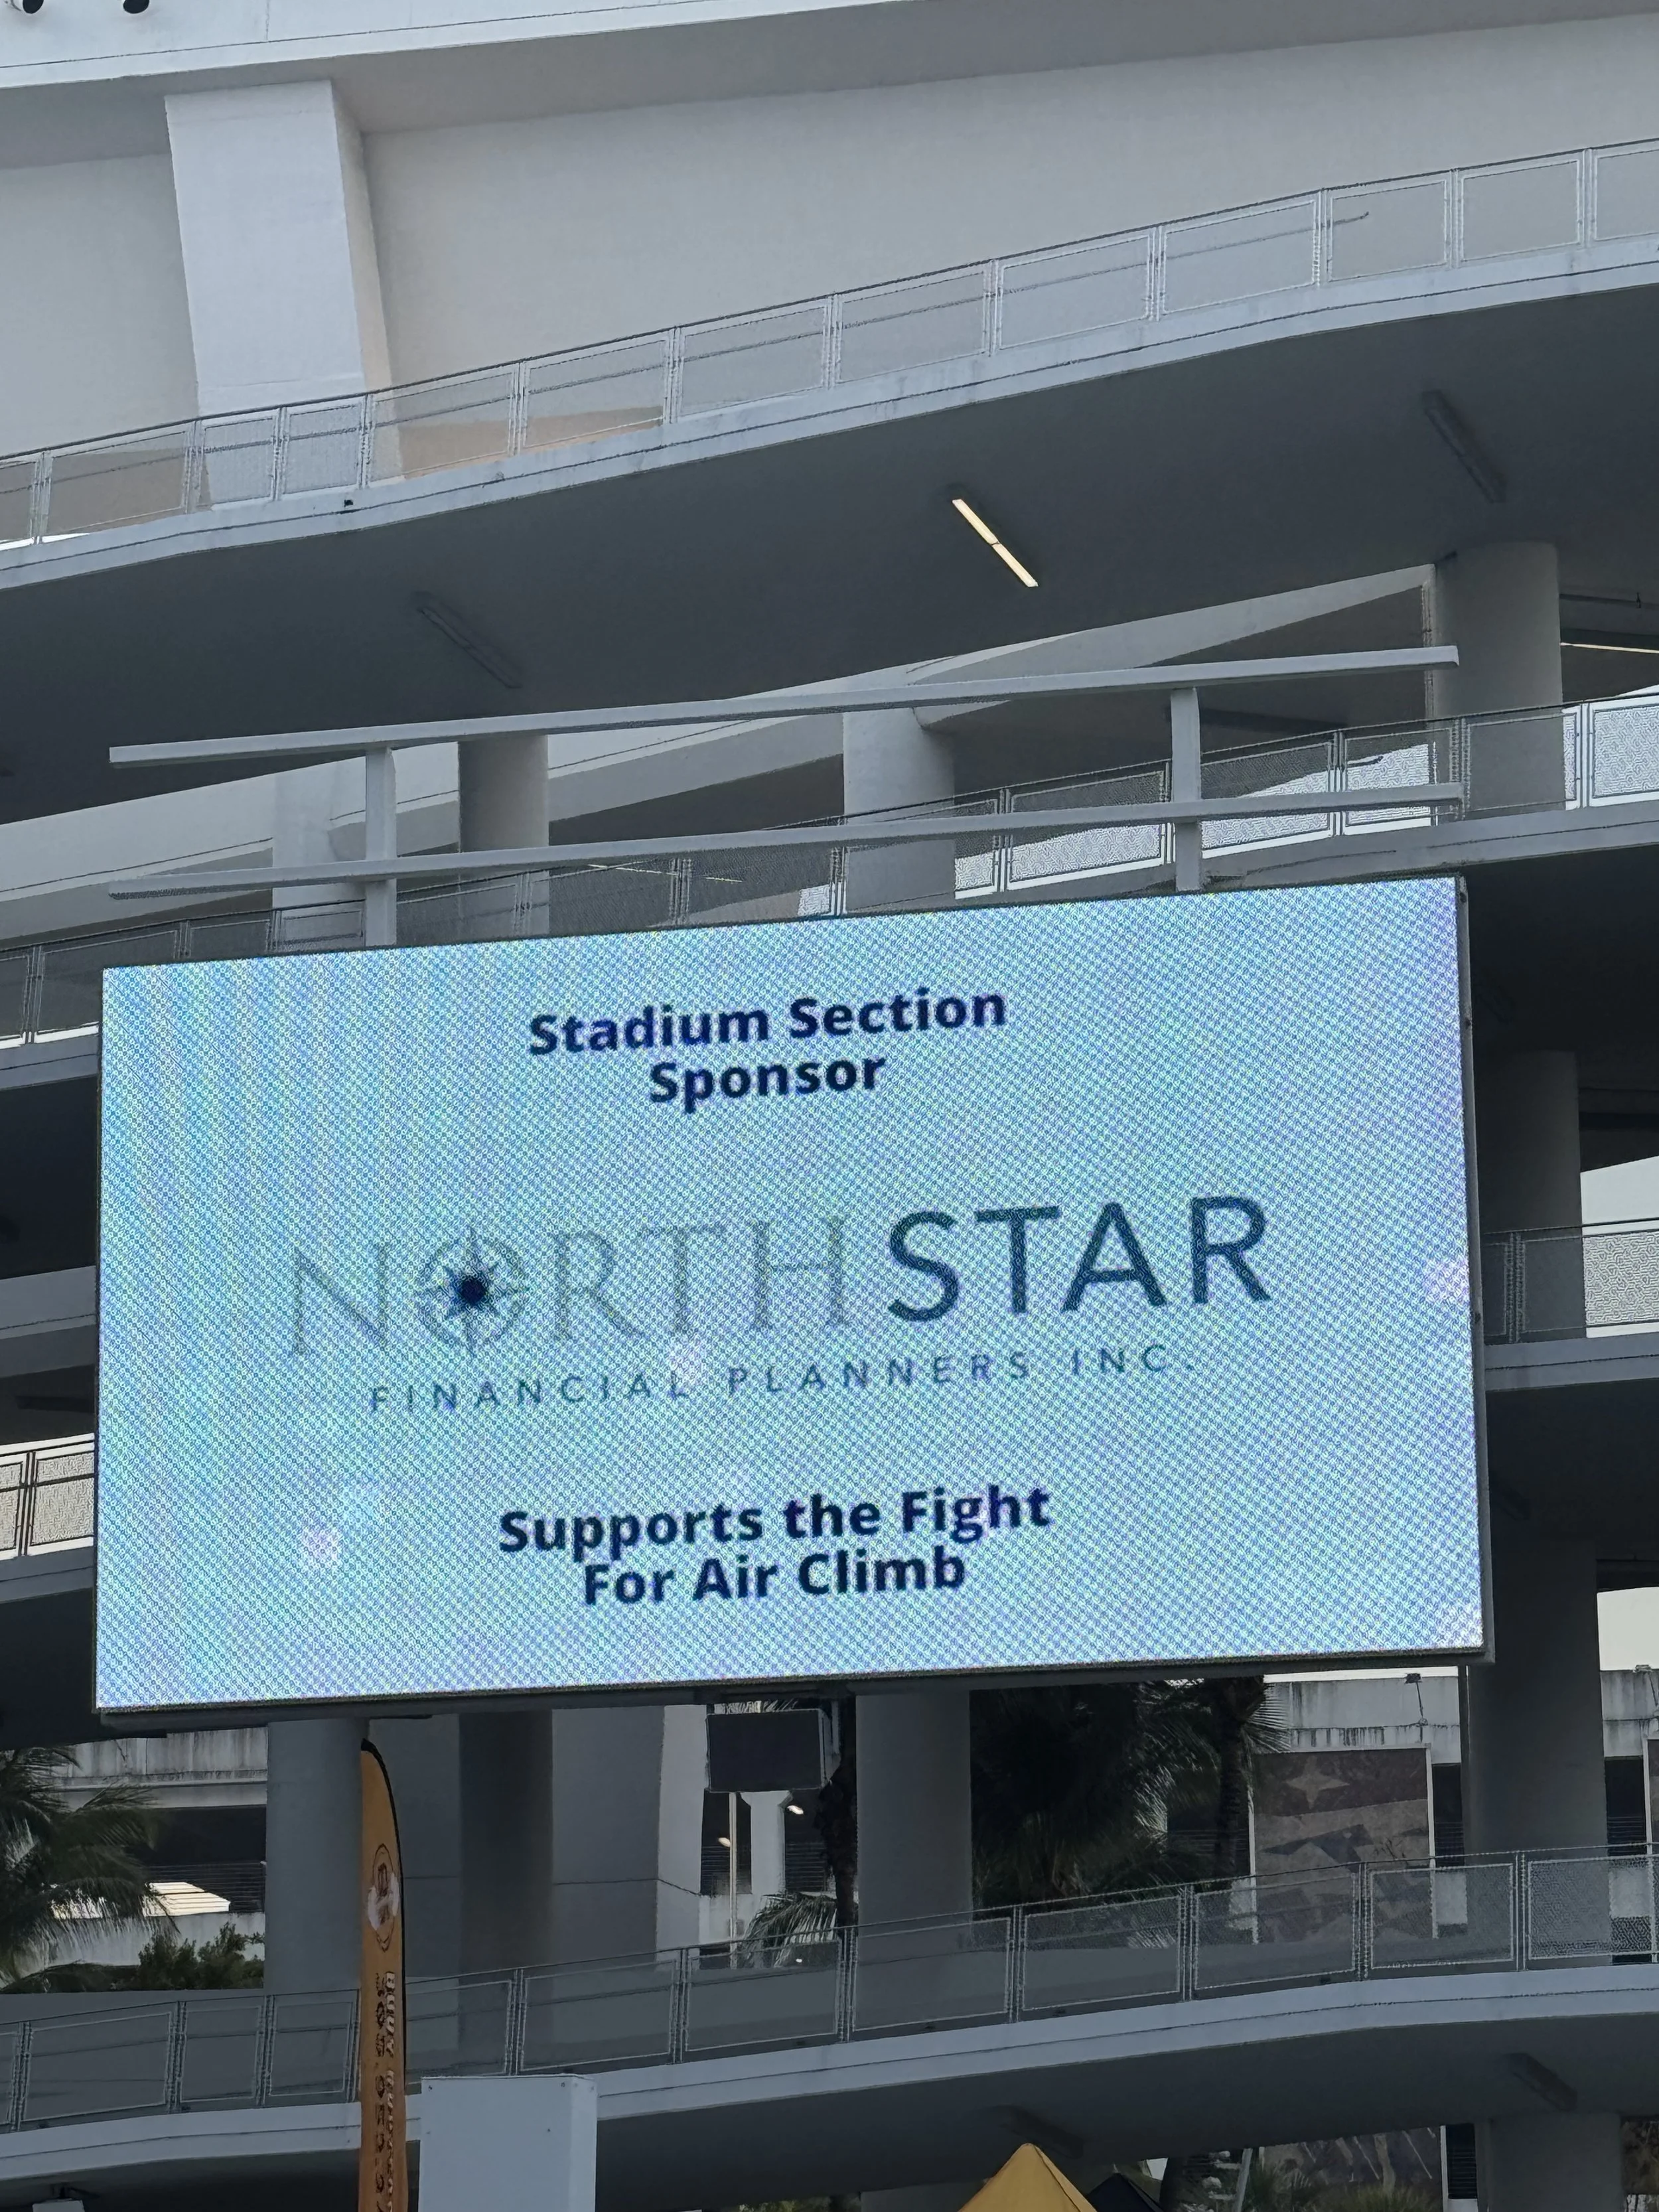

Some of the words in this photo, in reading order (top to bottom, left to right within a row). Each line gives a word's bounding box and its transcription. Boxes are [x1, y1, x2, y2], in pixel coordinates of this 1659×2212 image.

[529, 1005, 769, 1056] Stadium
[790, 988, 1006, 1039] Section
[650, 1059, 885, 1115] Sponsor
[369, 1369, 690, 1416] FINANCIAL
[727, 1350, 1031, 1396] PLANNERS
[1070, 1343, 1195, 1374] INC.
[499, 1501, 763, 1562] Supports
[783, 1493, 881, 1539] the
[902, 1484, 1051, 1544] Fight
[584, 1564, 676, 1606] For
[692, 1553, 778, 1601] Air
[797, 1546, 966, 1596] Climb
